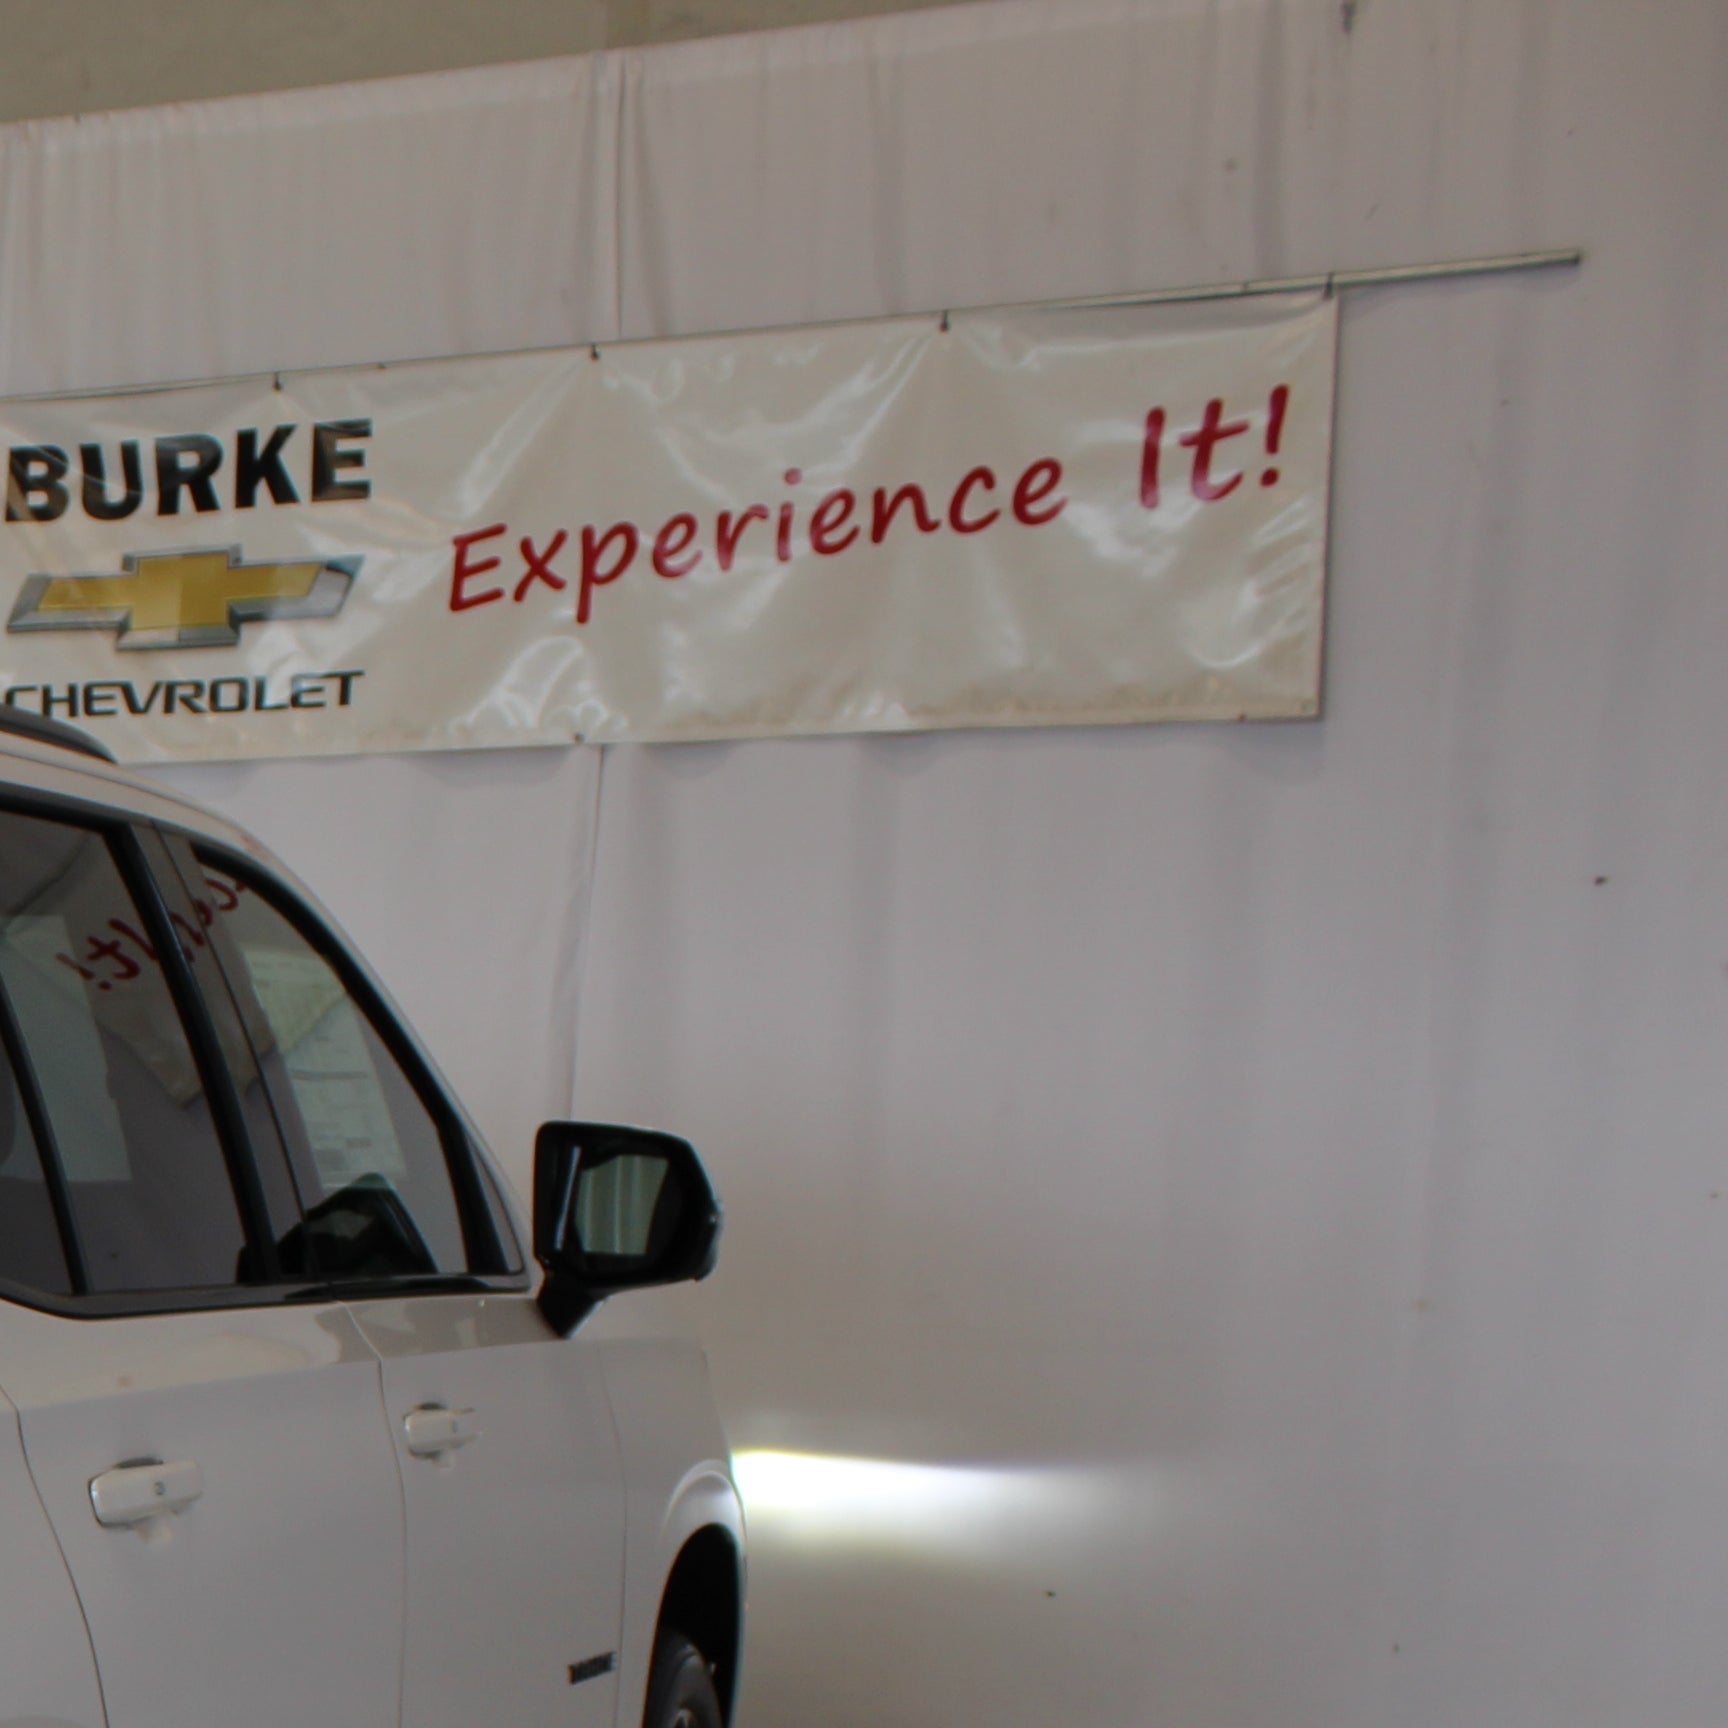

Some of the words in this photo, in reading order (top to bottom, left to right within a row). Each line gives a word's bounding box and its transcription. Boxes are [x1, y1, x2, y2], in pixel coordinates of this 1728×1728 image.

[5, 418, 373, 522] BURKE
[448, 457, 1068, 624] Experience
[1138, 384, 1289, 508] It!
[5, 670, 366, 719] CHEVROLET
